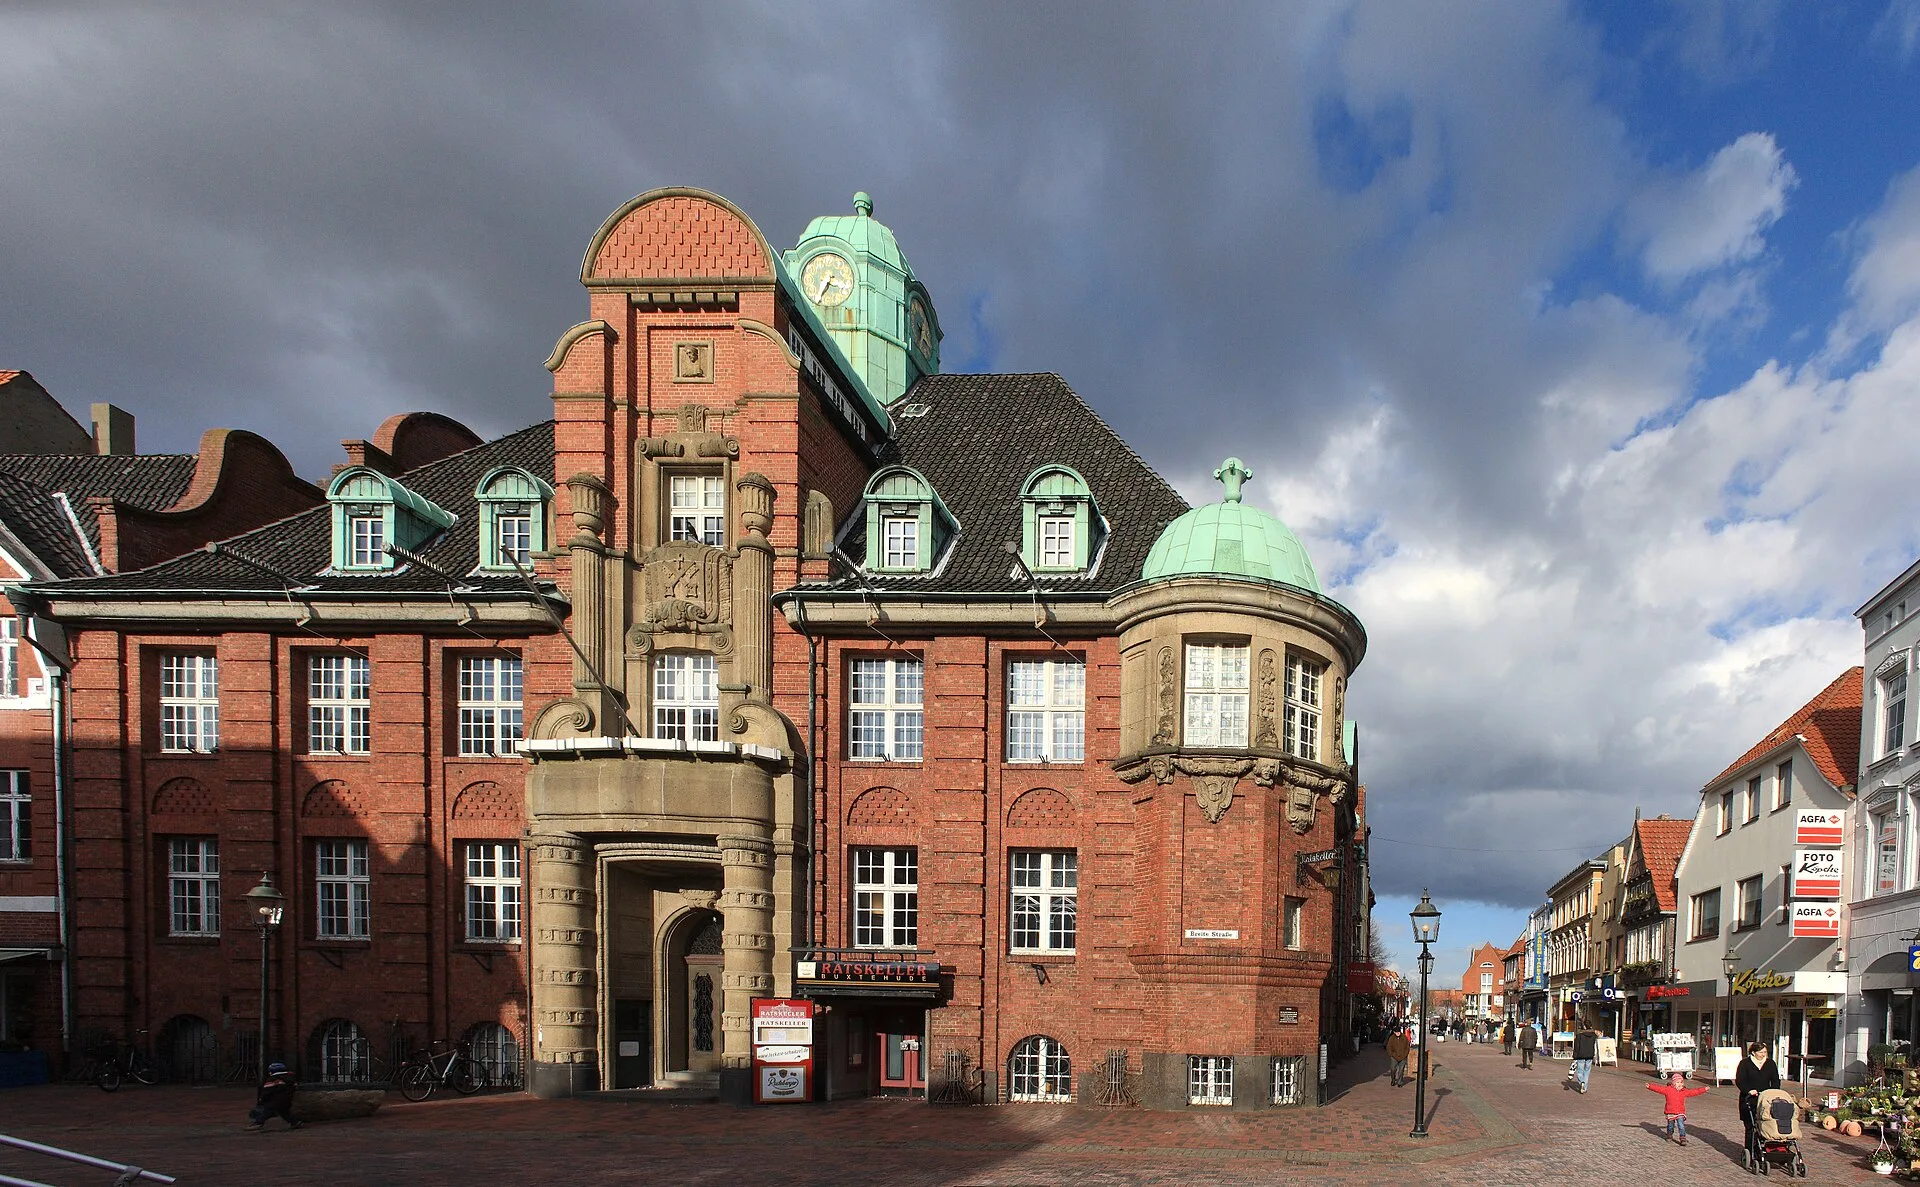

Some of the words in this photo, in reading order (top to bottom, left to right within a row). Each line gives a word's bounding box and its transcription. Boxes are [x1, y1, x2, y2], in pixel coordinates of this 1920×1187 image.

[1800, 815, 1826, 823] AGFA
[1803, 853, 1834, 862] FOTO
[1796, 908, 1822, 916] AGFA
[821, 963, 927, 976] RATSKELLER
[1805, 997, 1825, 1008] Nikon
